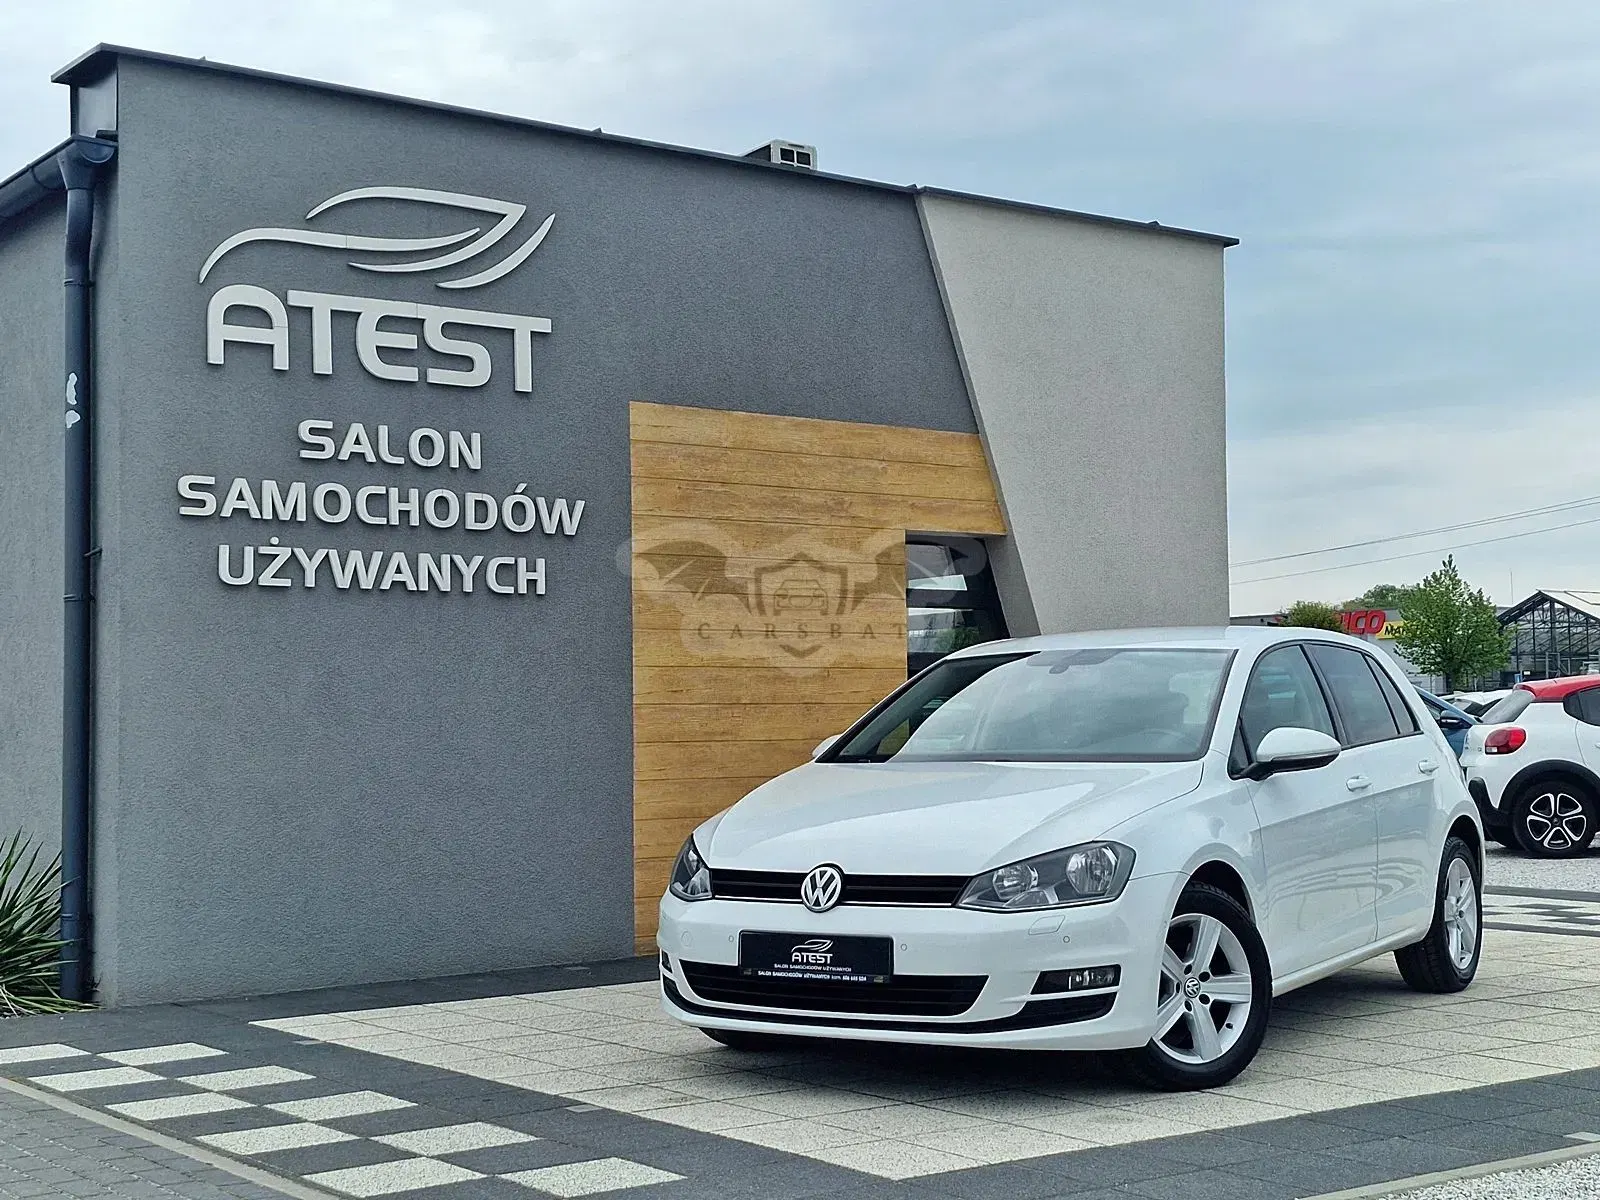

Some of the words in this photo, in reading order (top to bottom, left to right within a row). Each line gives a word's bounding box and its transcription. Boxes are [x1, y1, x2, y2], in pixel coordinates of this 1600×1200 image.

[207, 284, 552, 392] ATEST
[298, 419, 482, 470] SALON
[177, 474, 586, 536] SAMOCHODÓW
[218, 536, 546, 595] UŻYWANYCH
[1342, 609, 1386, 634] ICO
[791, 952, 833, 964] ATEST
